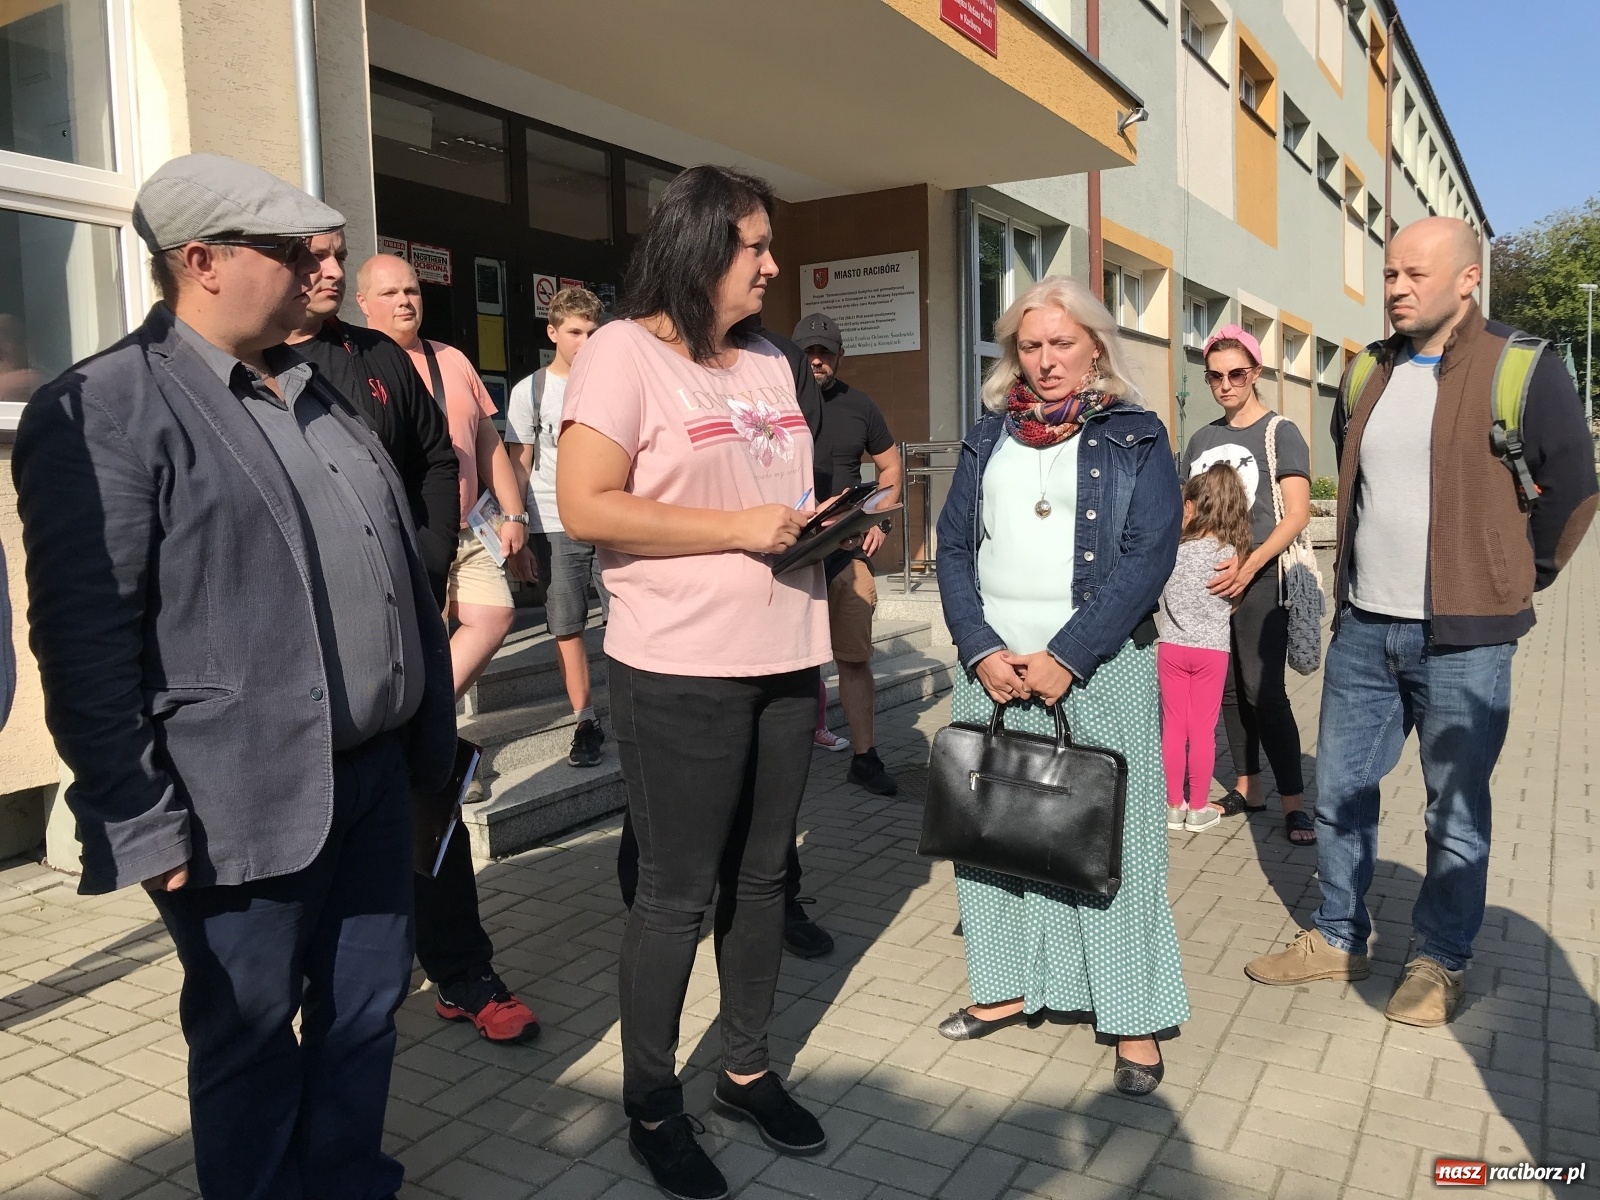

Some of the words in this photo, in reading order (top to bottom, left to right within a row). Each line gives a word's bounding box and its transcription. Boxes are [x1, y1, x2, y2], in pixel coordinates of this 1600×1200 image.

[413, 252, 448, 265] NORTHERN
[413, 261, 448, 273] OCHRONA
[834, 269, 861, 280] MIASTO
[863, 263, 900, 277] RACIBÓRZ
